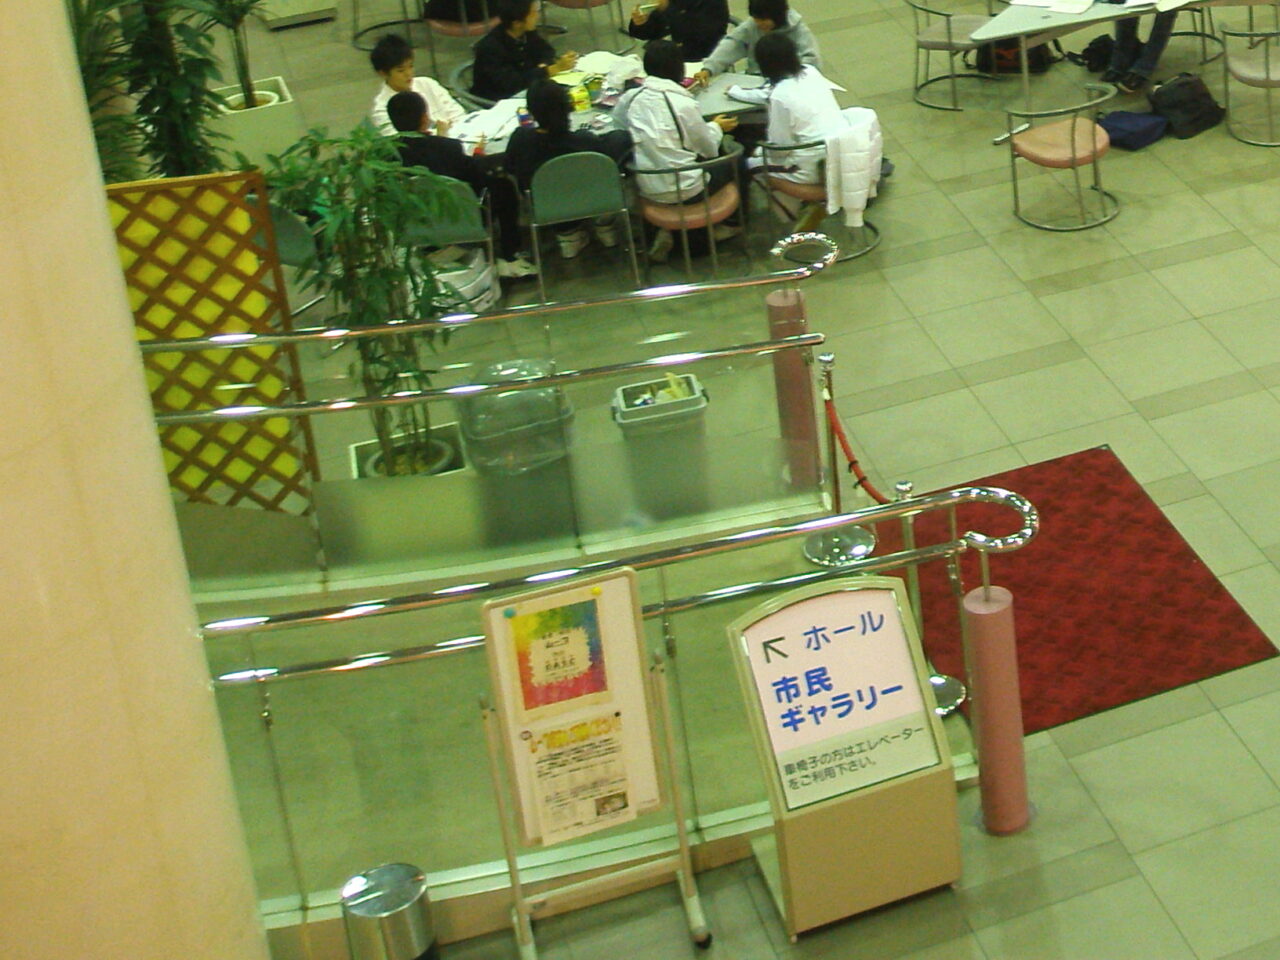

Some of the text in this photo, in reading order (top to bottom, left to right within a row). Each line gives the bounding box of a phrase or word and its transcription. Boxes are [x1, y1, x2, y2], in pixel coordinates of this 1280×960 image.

[804, 611, 884, 651] ホール
[771, 666, 834, 704] 市民
[780, 684, 903, 732] ギャラリー
[783, 727, 925, 776] 車椅子の方はエレベーター
